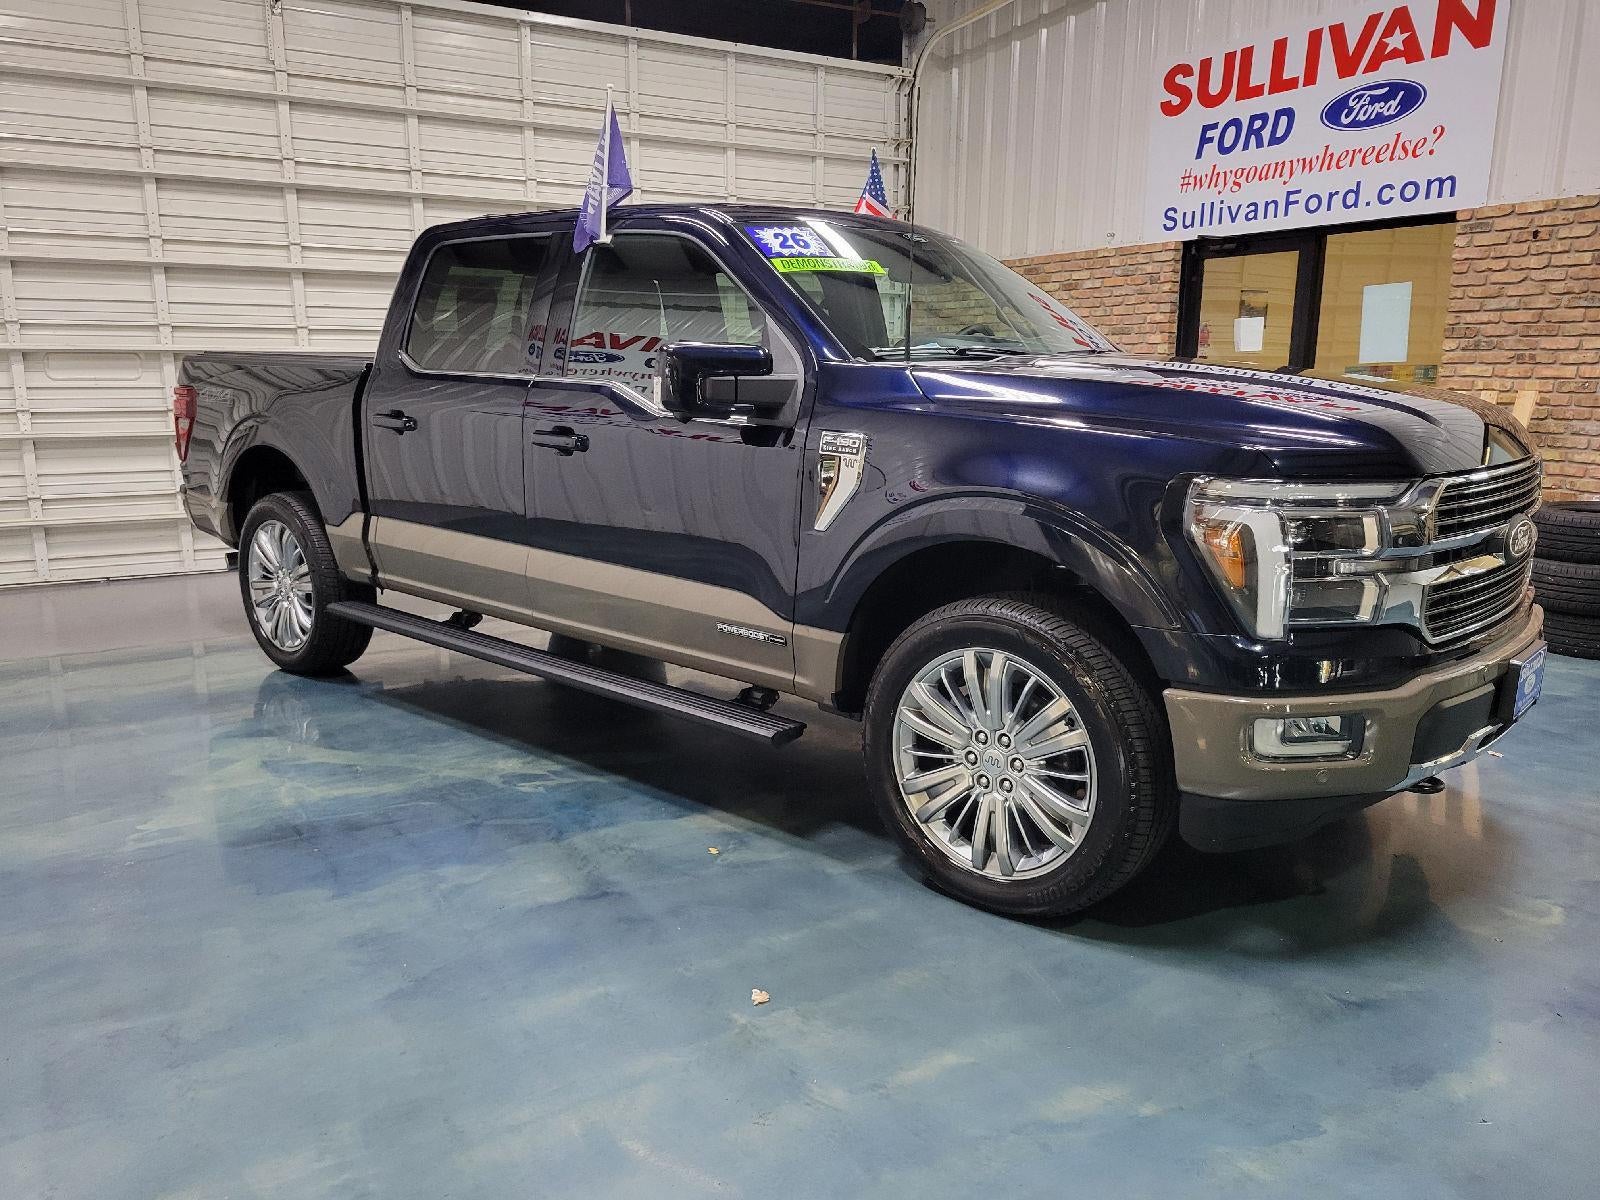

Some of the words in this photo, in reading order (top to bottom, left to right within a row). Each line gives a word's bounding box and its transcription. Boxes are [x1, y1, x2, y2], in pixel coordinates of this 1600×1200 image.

[1160, 0, 1497, 117] SULLIVAN
[1341, 87, 1405, 125] Ford
[1195, 107, 1296, 160] FORD
[1180, 124, 1446, 195] #whygoanywhereelse?
[1162, 174, 1457, 232] SullivanFord.com
[773, 232, 811, 250] 26
[780, 257, 879, 273] DEMONSTROR
[716, 622, 769, 642] POWERBOOST
